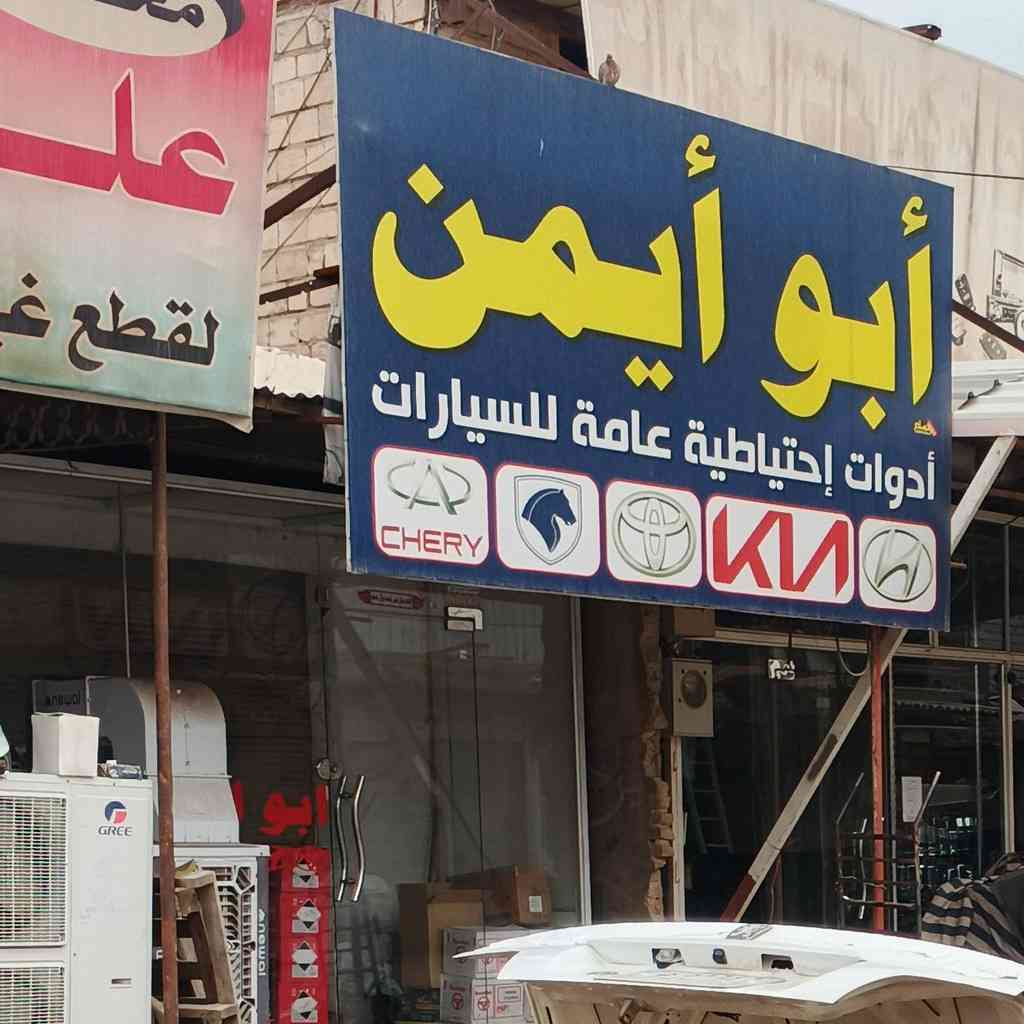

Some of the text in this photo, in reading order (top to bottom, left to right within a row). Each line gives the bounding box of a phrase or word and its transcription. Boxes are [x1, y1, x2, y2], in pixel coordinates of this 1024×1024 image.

[372, 134, 934, 430] أبو أيمن
[68, 289, 220, 371] لقطع
[371, 370, 935, 510] أدوات إحتياطية عامة للسيارات
[380, 525, 484, 558] CHERY
[97, 826, 133, 837] GREE
